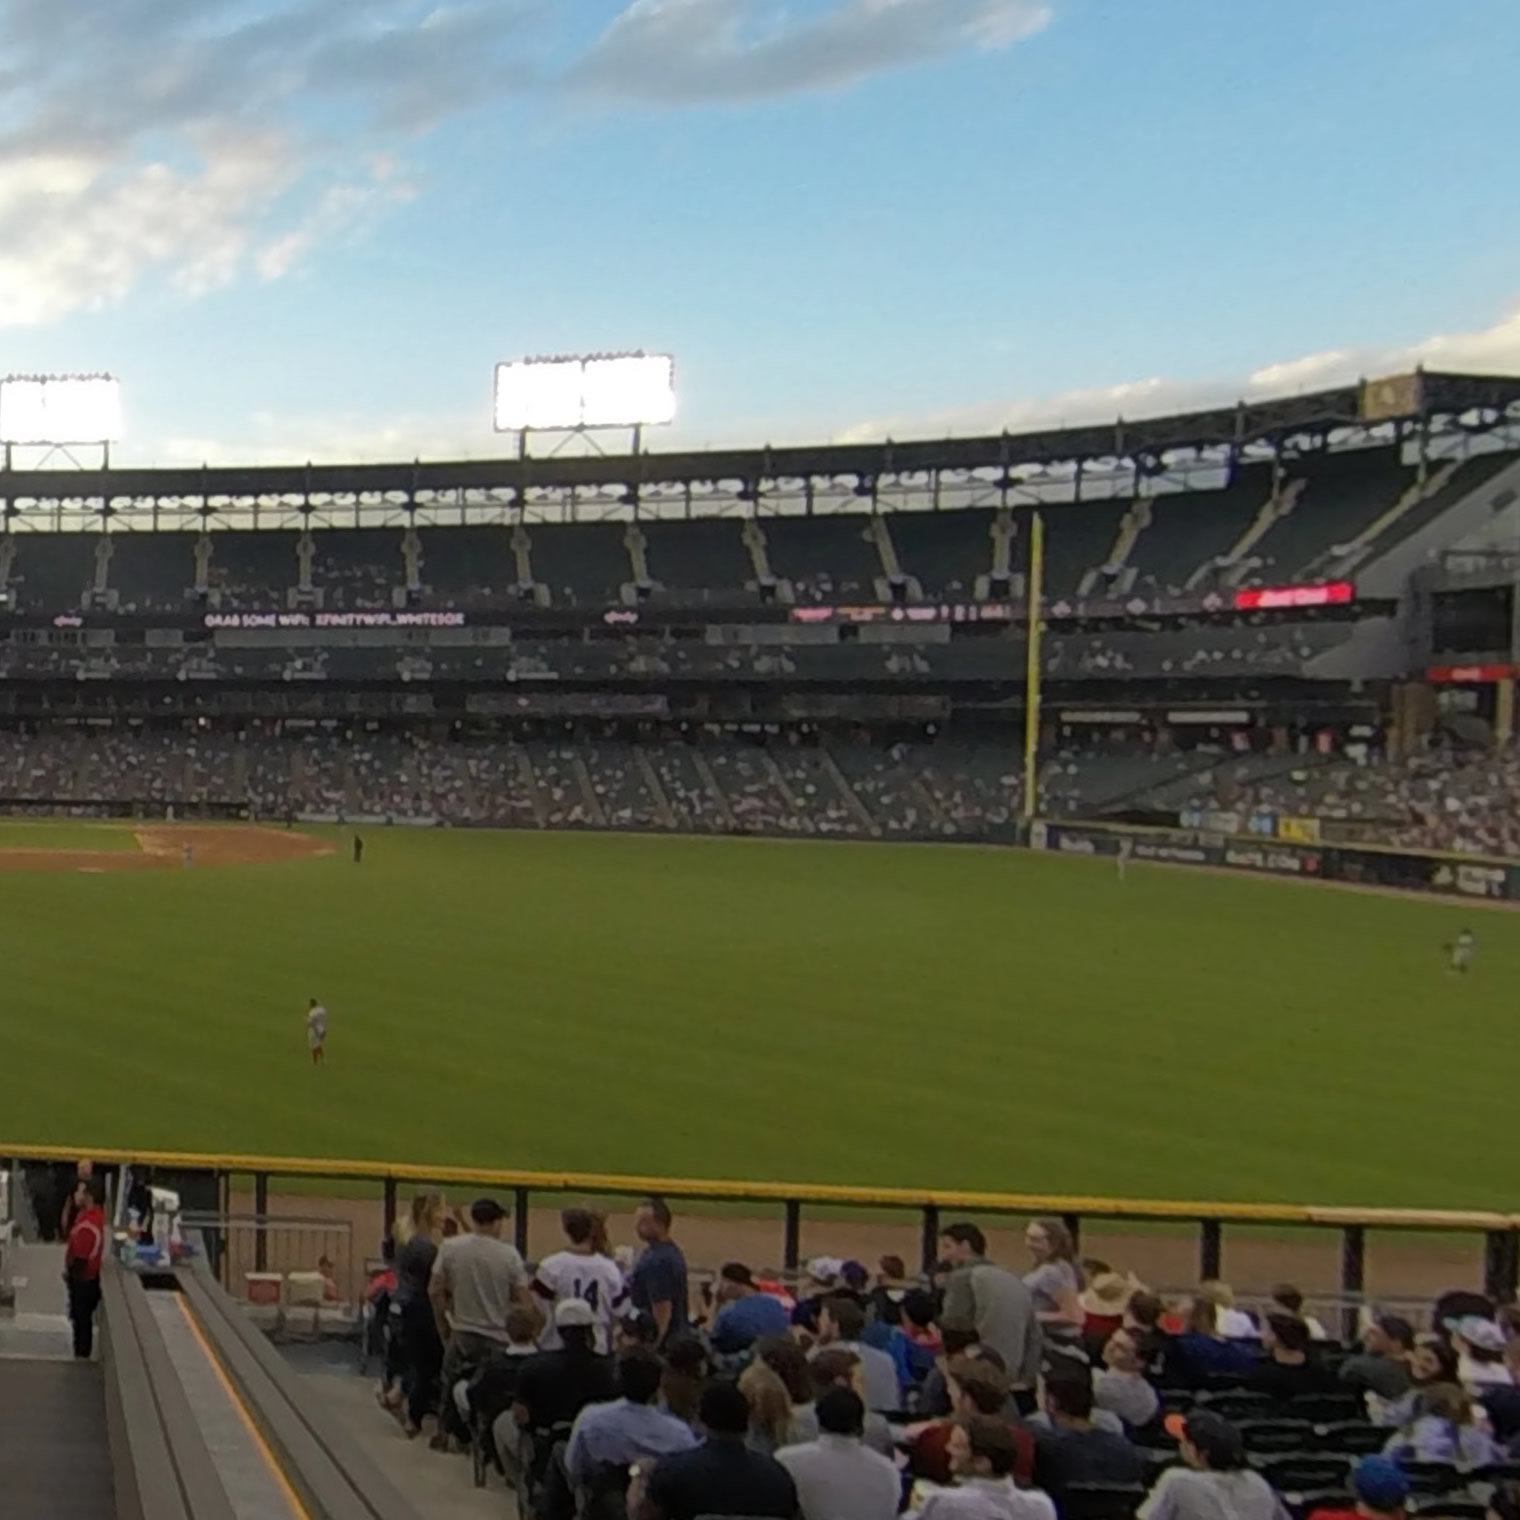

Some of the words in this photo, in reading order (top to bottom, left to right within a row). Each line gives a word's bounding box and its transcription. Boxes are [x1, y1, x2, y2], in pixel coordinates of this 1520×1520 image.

[204, 613, 240, 627] GRAB
[242, 613, 276, 627] SOME
[573, 1278, 599, 1312] 14
